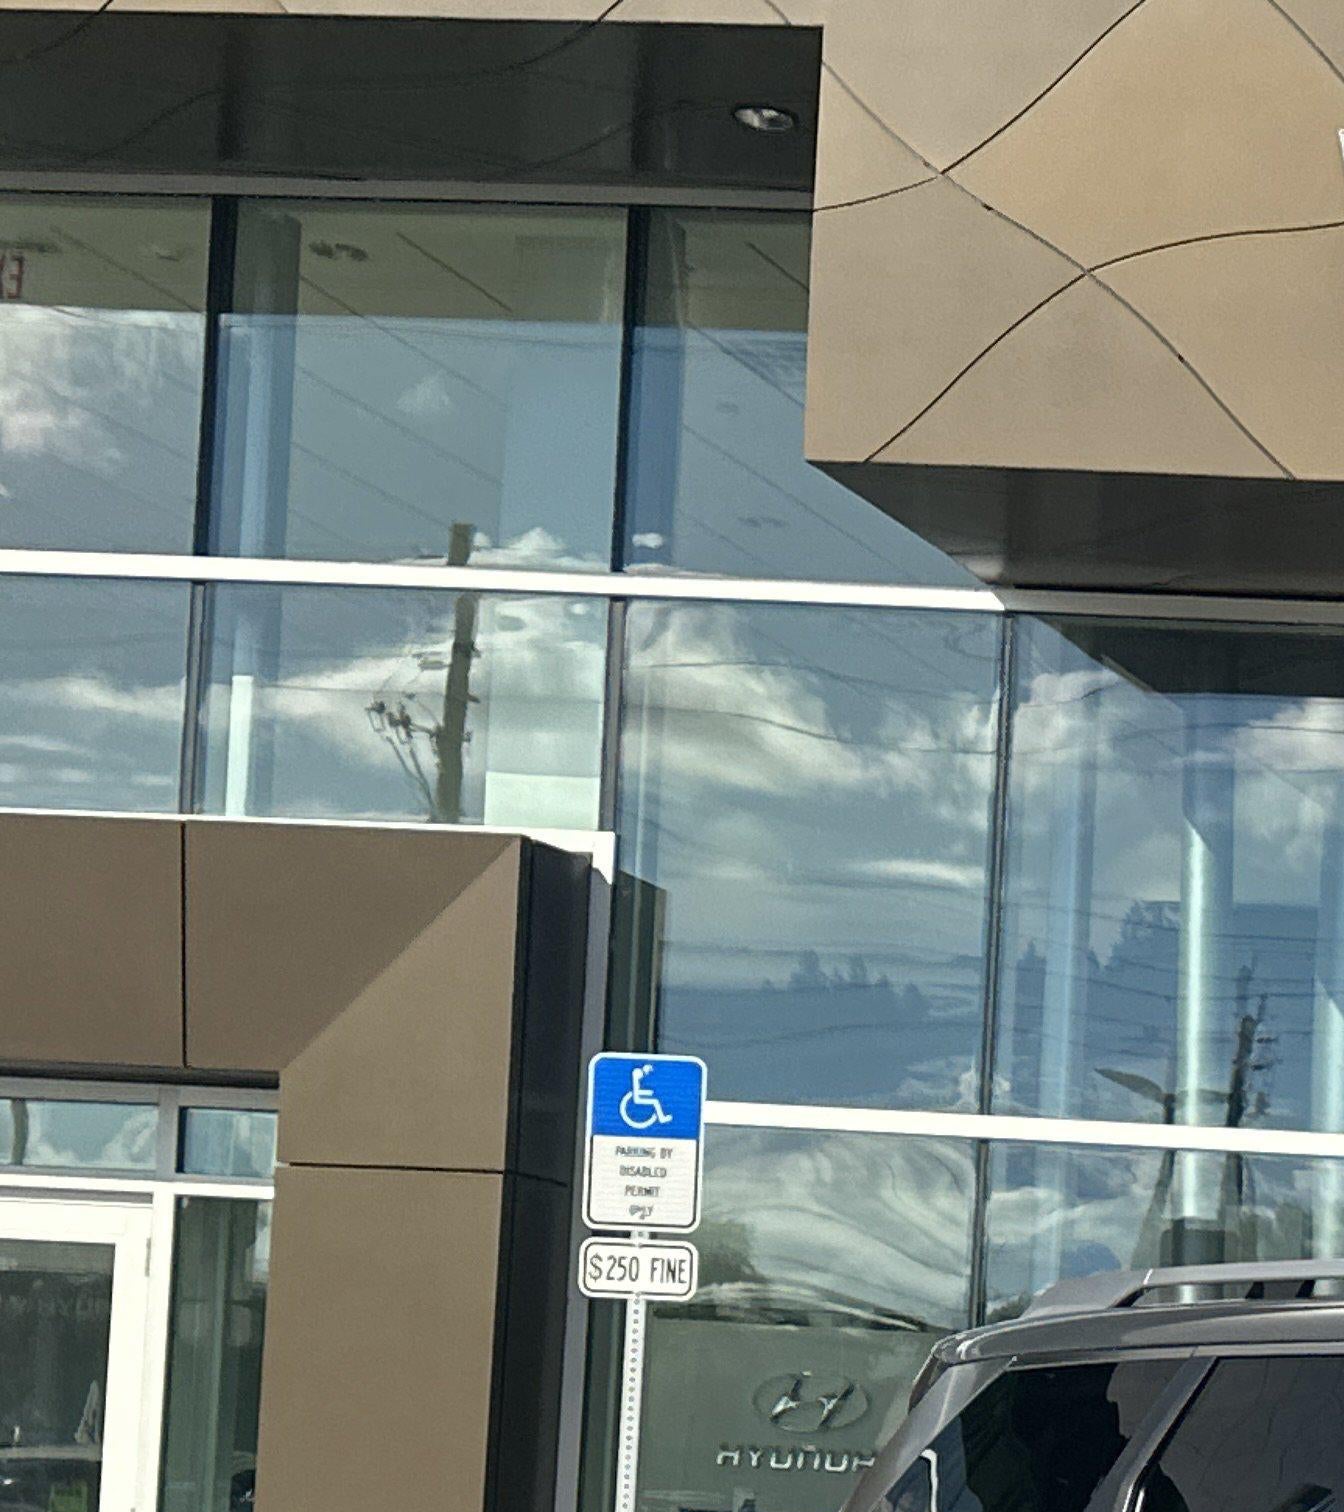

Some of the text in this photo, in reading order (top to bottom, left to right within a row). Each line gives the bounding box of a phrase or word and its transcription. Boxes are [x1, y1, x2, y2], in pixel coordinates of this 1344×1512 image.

[615, 1145, 672, 1158] PARKING BY
[619, 1165, 667, 1178] DISABLED
[624, 1184, 660, 1197] PERMIT
[588, 1252, 686, 1283] $250 FINE
[715, 1444, 876, 1473] HYUNDA
